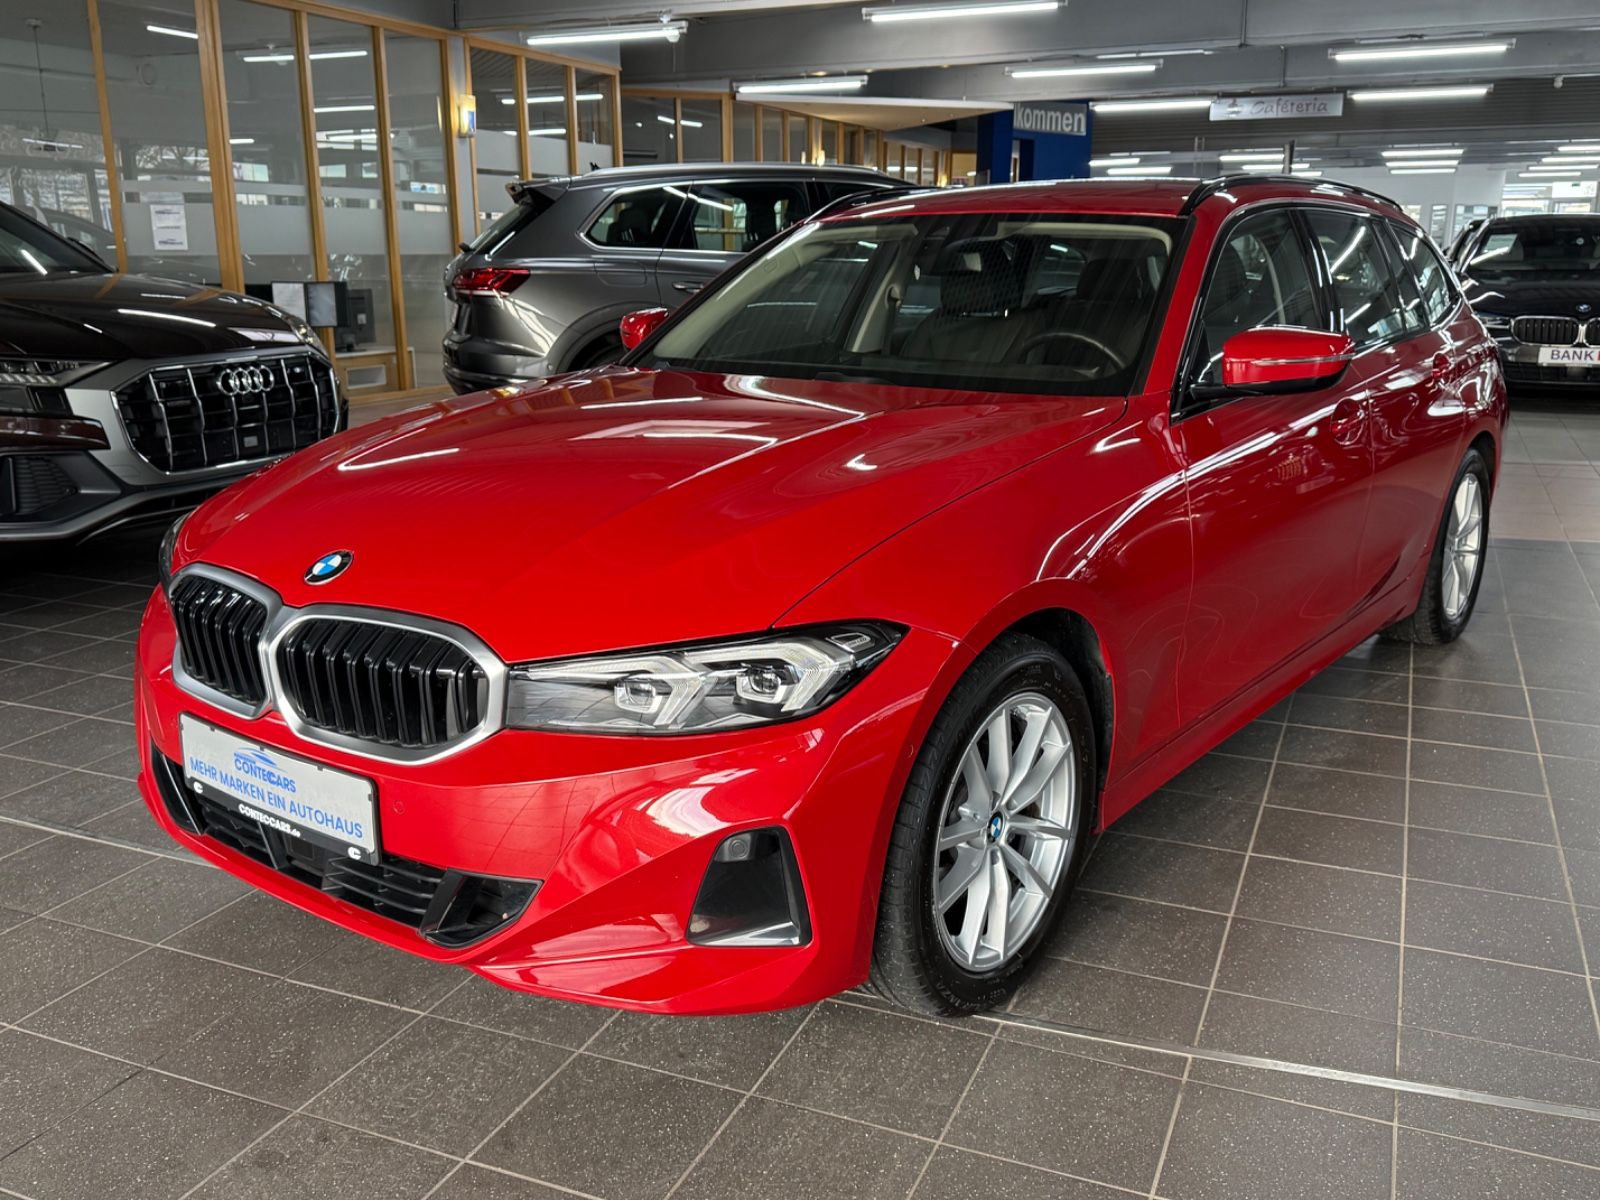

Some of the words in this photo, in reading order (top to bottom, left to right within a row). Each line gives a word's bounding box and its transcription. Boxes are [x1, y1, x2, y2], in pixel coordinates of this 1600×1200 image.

[1551, 349, 1594, 361] BANK
[190, 757, 217, 781] MEHR
[220, 770, 266, 802] MARKEN
[267, 791, 286, 811] EIN
[290, 800, 363, 838] AUTOHAUS
